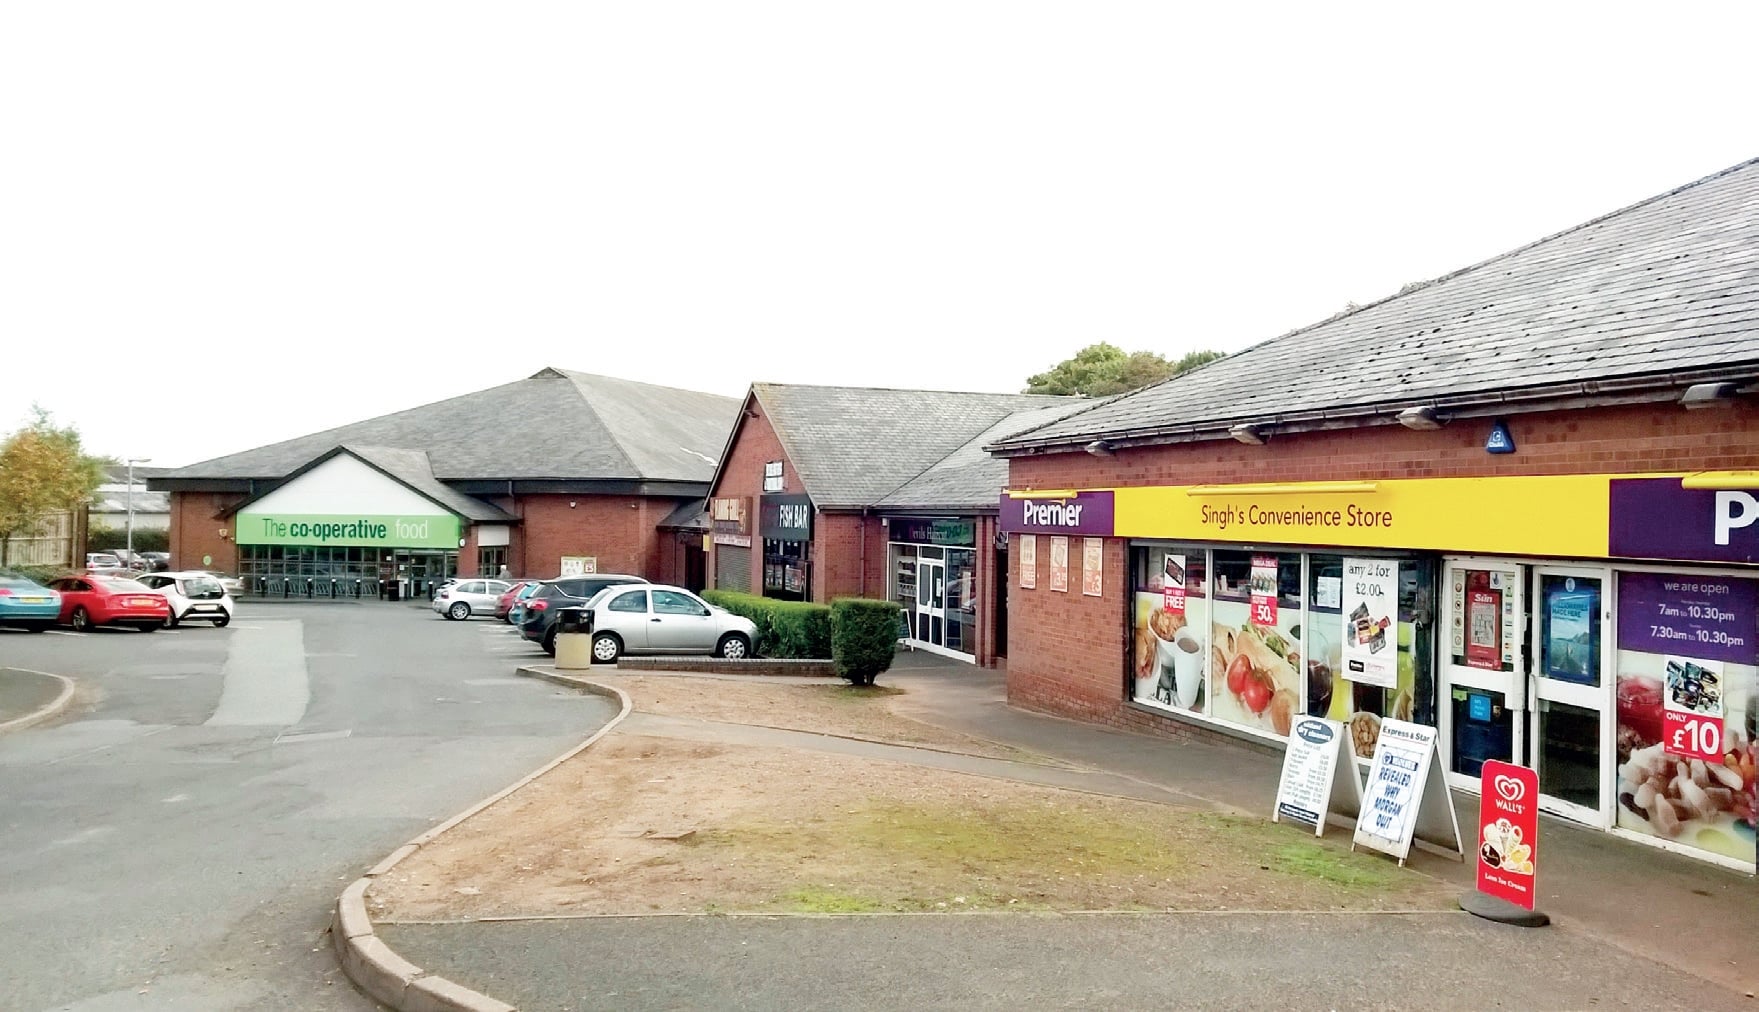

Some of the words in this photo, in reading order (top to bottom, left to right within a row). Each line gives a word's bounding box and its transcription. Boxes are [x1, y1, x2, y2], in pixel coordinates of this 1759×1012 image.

[779, 504, 793, 528] FISH
[794, 504, 808, 529] BAR
[1023, 499, 1083, 527] Premier
[1201, 504, 1245, 530] Singh's
[1249, 504, 1341, 527] Convenience
[1347, 504, 1393, 528] Store
[262, 518, 287, 537] The
[289, 519, 387, 541] co-operative
[395, 520, 429, 540] food
[1348, 564, 1366, 580] any
[1367, 565, 1374, 576] 2
[1375, 564, 1391, 578] for
[1474, 593, 1493, 603] Sun
[1663, 582, 1680, 592] we
[1681, 583, 1699, 592] are
[1700, 584, 1730, 597] open
[1165, 595, 1184, 610] FREE
[1658, 603, 1679, 617] 7am
[1687, 605, 1736, 624] 10.30pm
[1650, 625, 1687, 641] 7.30am
[1696, 630, 1744, 648] 10.30pm
[1666, 712, 1687, 722] ONLY
[1382, 725, 1409, 739] Express
[1409, 731, 1415, 740] &
[1415, 732, 1431, 742] Star
[1672, 719, 1720, 755] £10
[1379, 767, 1412, 788] REVEALED
[1384, 784, 1401, 798] WHY
[1374, 796, 1402, 817] MORGAN
[1495, 798, 1523, 815] WALL'S
[1375, 813, 1393, 830] QUIT
